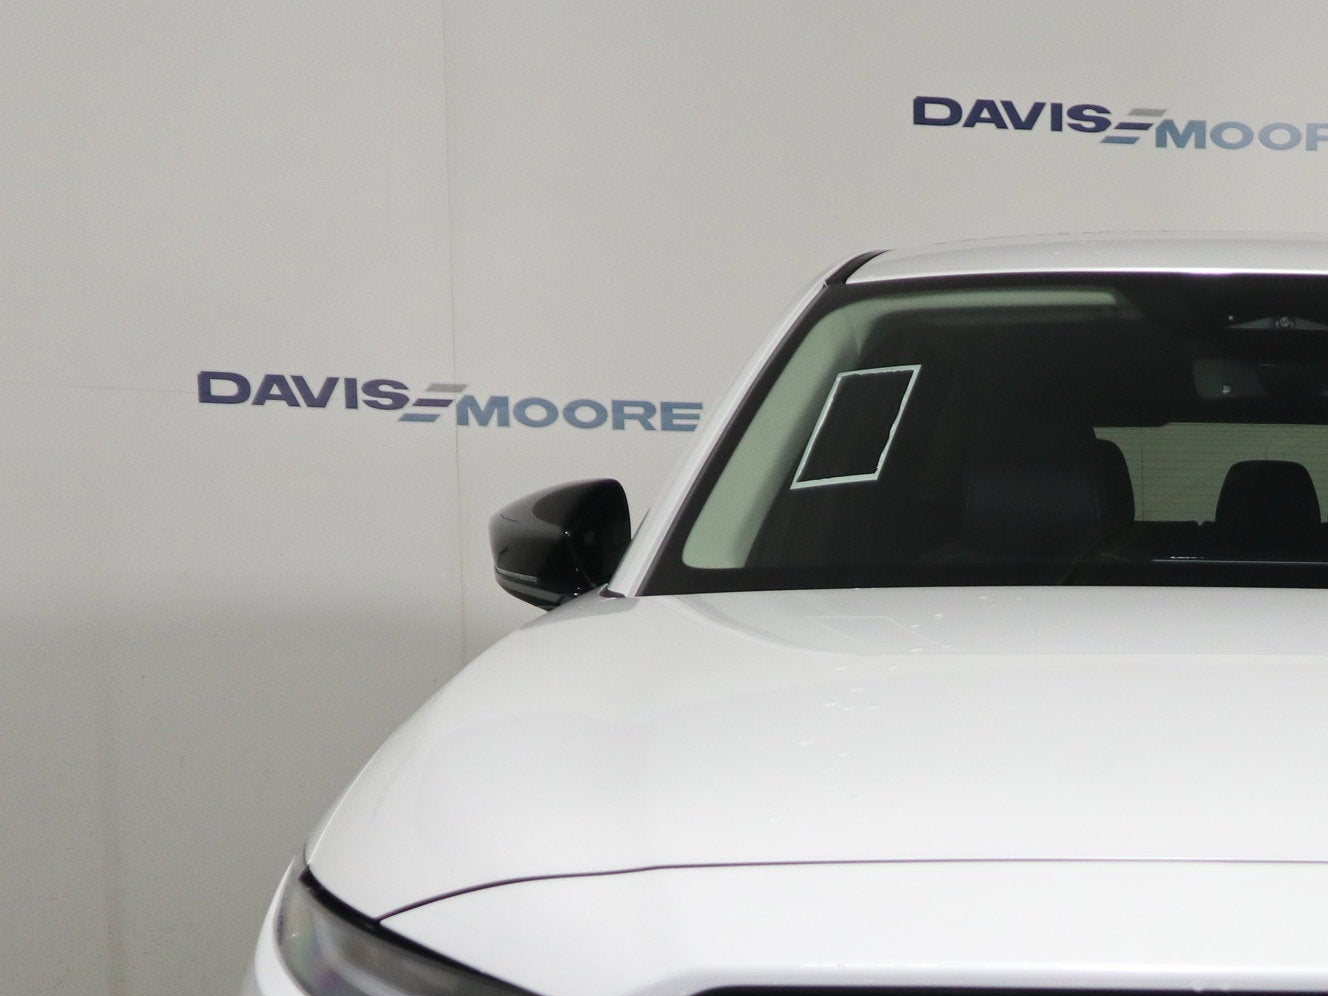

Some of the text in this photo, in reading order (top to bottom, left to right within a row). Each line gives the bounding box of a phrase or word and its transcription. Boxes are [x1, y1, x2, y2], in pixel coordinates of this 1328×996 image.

[912, 95, 1111, 133] DAVIS
[197, 371, 703, 432] DAVIS MOORE
